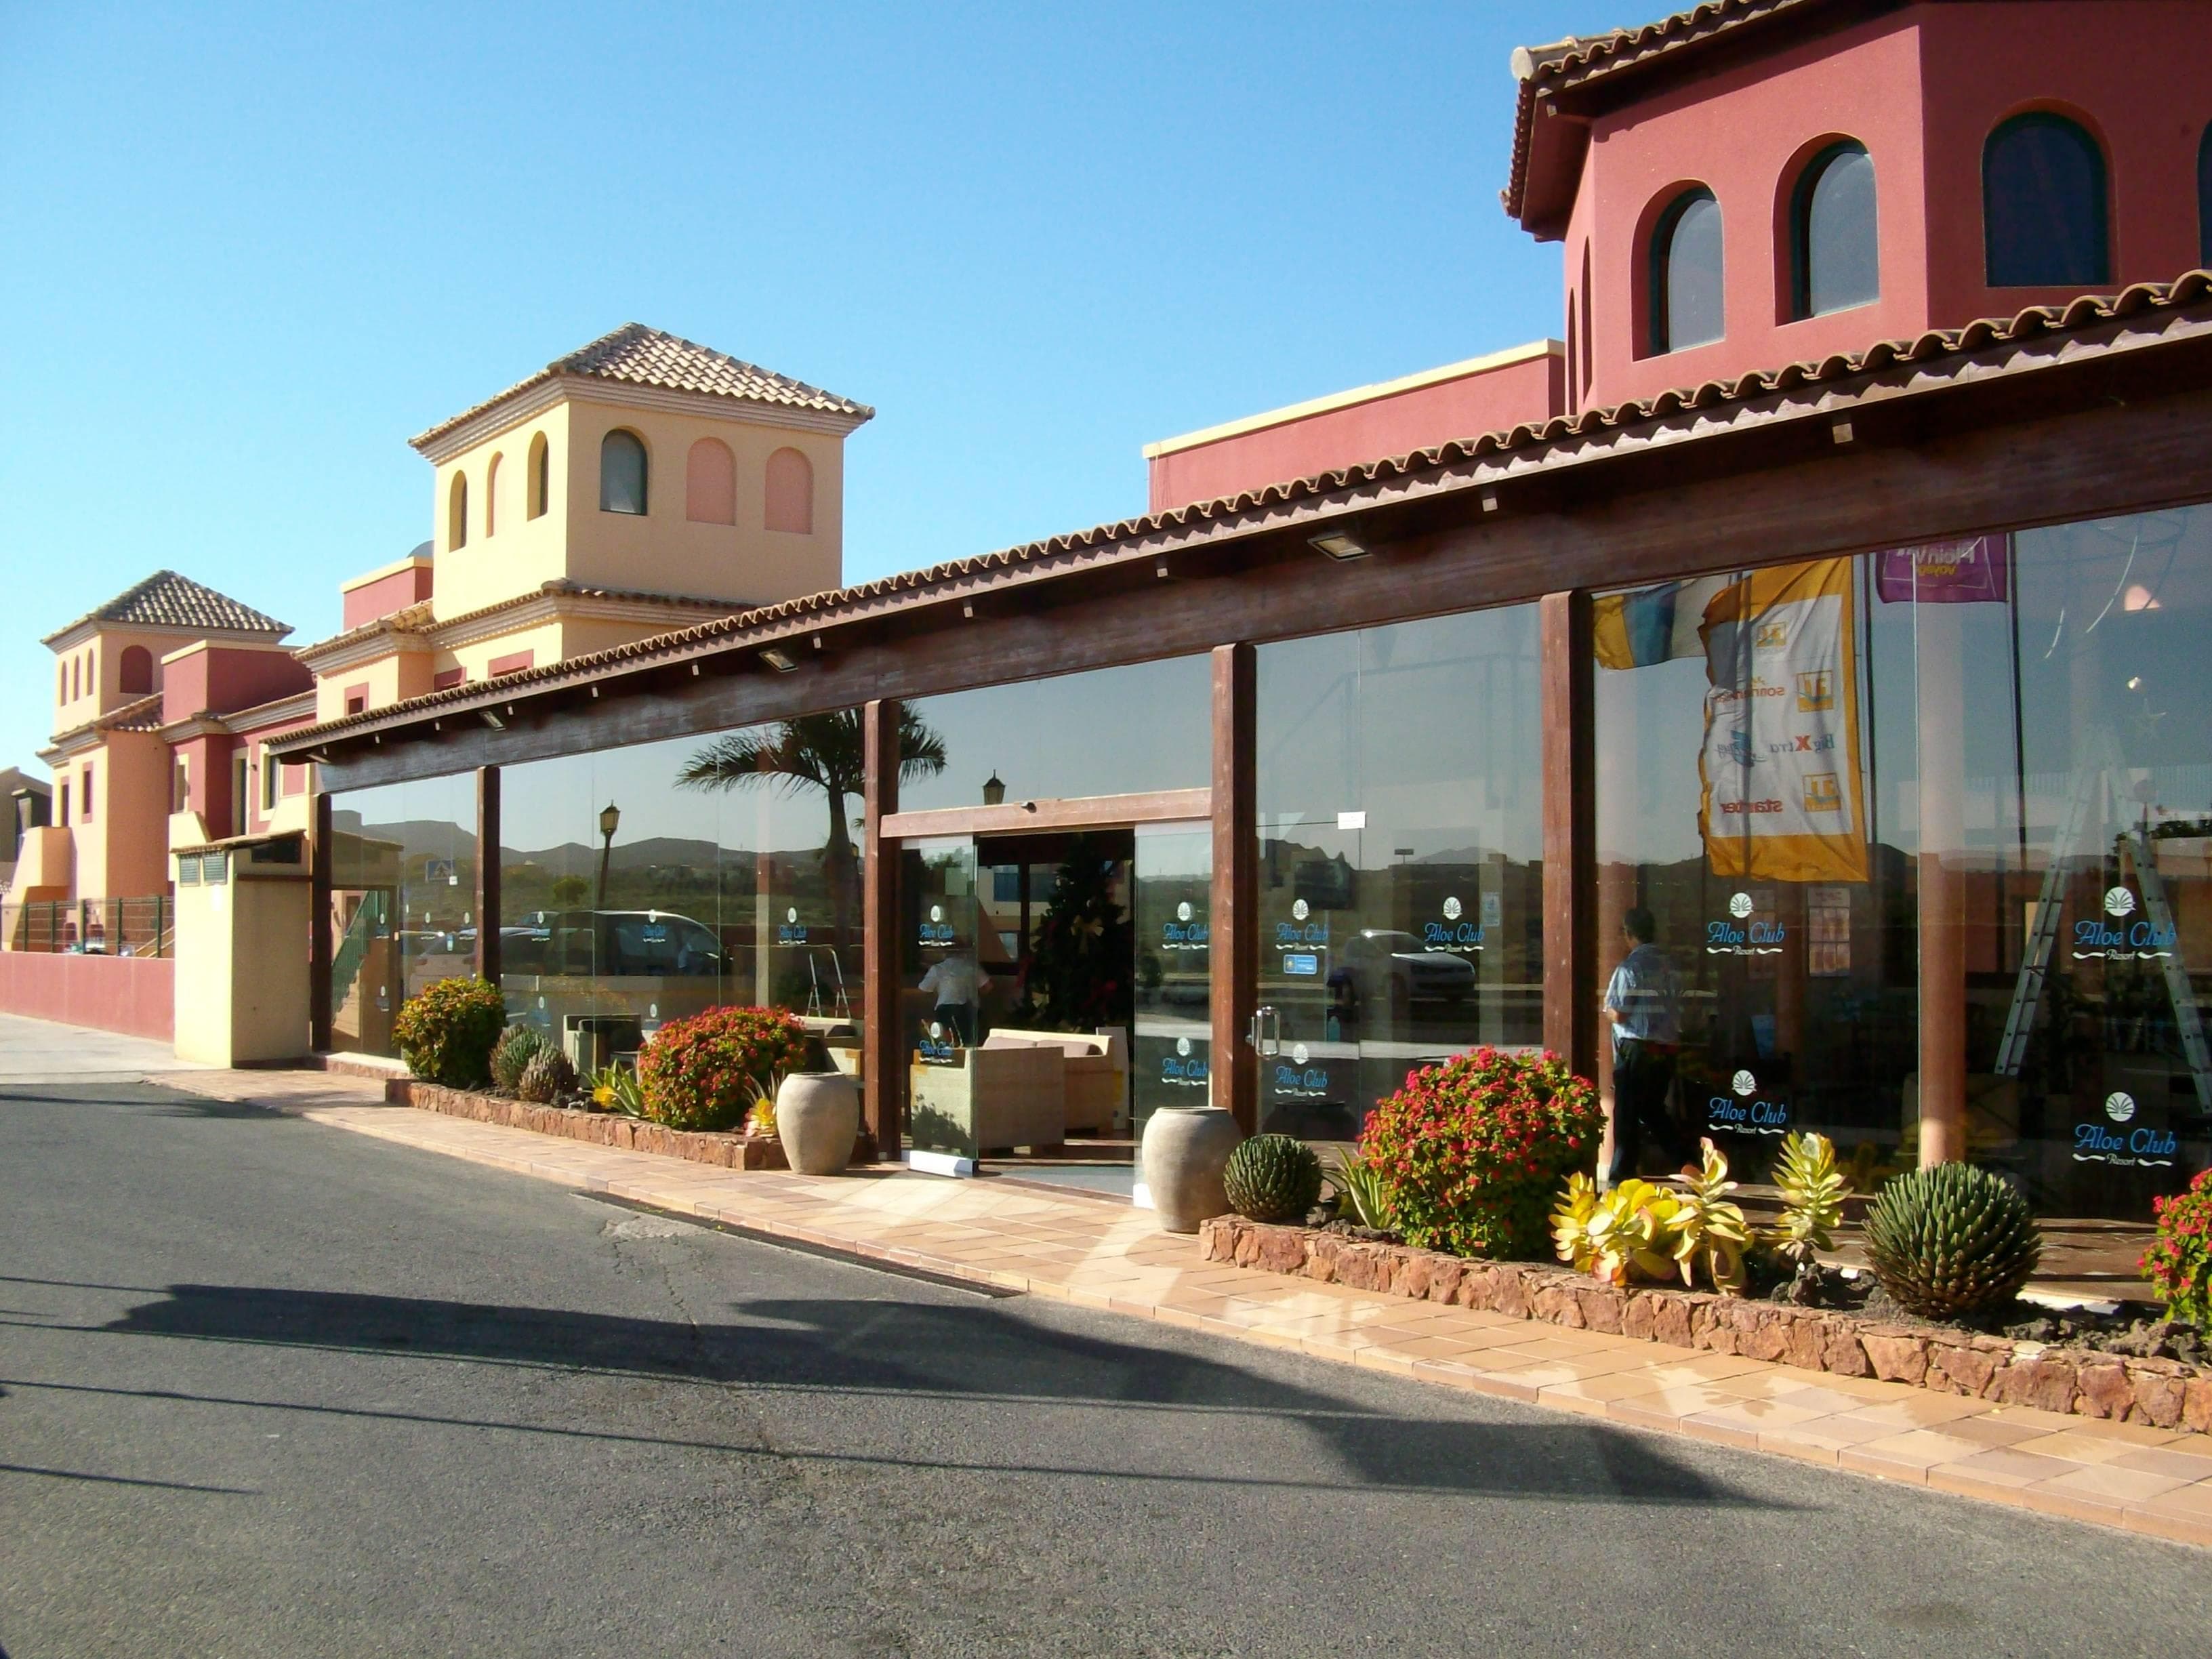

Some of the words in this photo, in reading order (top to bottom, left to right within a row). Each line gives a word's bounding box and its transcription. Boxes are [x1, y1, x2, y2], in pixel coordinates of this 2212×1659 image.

[1305, 923, 1328, 941] Club
[1425, 922, 1454, 942] Aloe
[1456, 922, 1485, 942] Club
[1707, 921, 1746, 943] Aloe
[1748, 922, 1785, 944] Club
[2074, 920, 2124, 945] Aloe
[2130, 921, 2177, 947] Club
[1275, 1065, 1301, 1085] Aloe
[1303, 1069, 1328, 1088] Club
[1708, 1097, 1746, 1120] Aloe
[1751, 1101, 1787, 1124] Club
[2074, 1123, 2123, 1150] Aloe
[2130, 1128, 2176, 1154] Club
